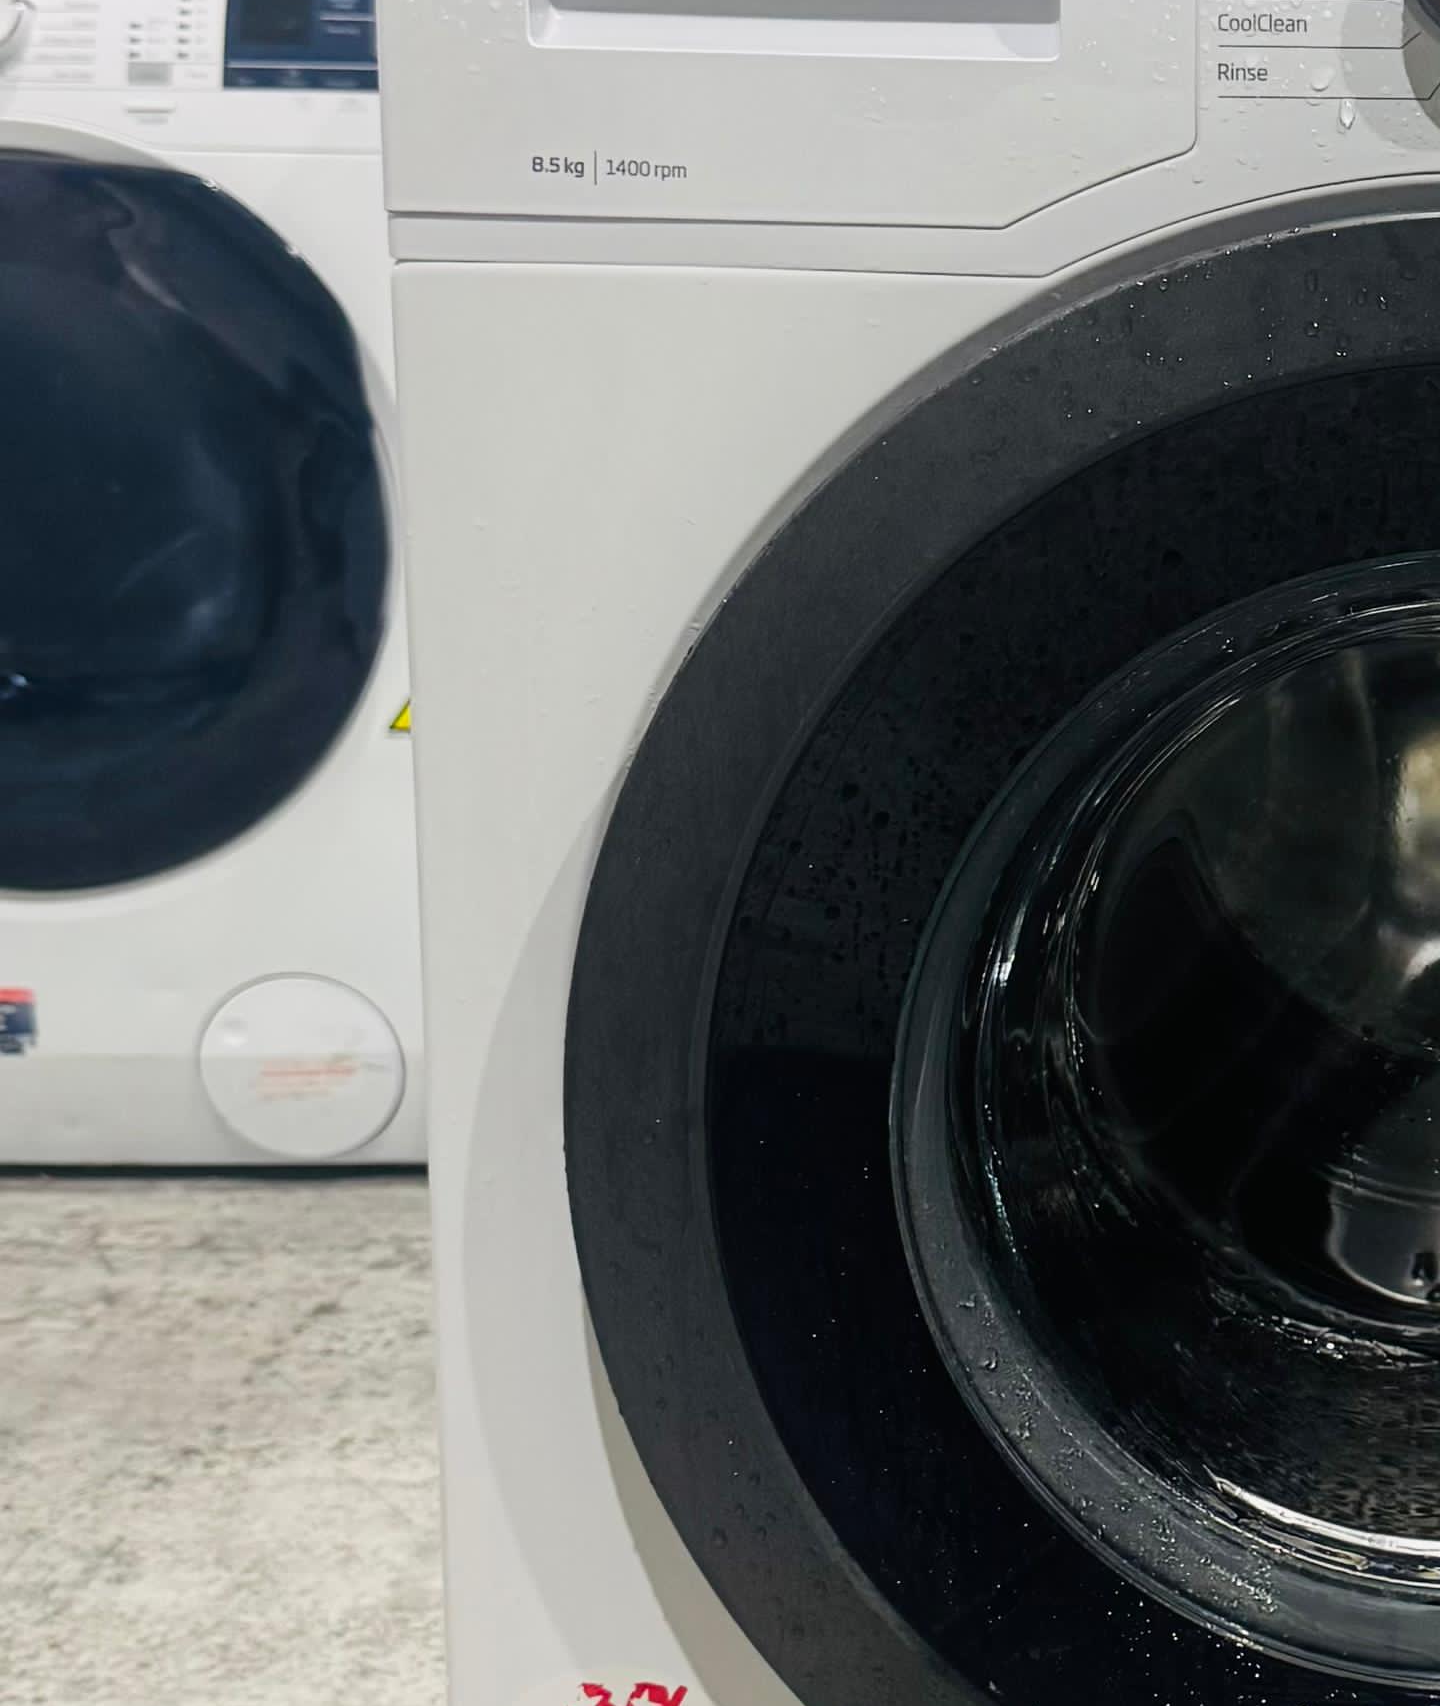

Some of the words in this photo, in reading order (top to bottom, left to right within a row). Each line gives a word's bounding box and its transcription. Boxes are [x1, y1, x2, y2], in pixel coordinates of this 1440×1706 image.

[1217, 13, 1308, 33] CoolClean
[1217, 62, 1268, 82] Rinse
[532, 156, 560, 173] 8.5
[564, 157, 585, 178] kg
[606, 159, 650, 177] 1400
[654, 164, 687, 181] rpm
